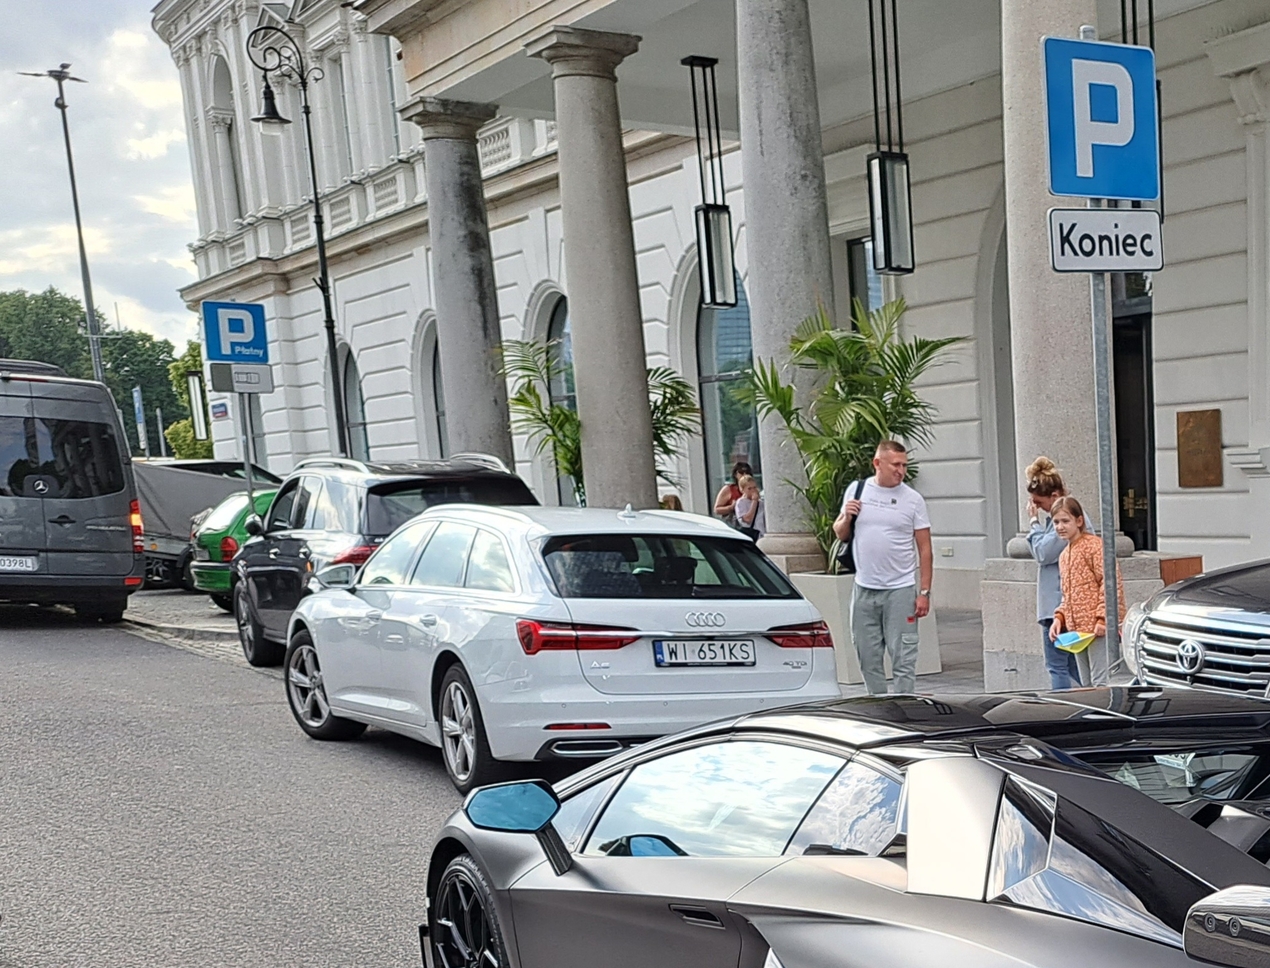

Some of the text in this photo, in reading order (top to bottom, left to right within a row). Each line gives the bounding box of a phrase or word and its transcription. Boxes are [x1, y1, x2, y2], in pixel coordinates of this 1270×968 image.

[1071, 58, 1135, 178] P
[1058, 222, 1155, 257] Koniec
[217, 308, 255, 355] P
[667, 643, 750, 661] WI 651KS
